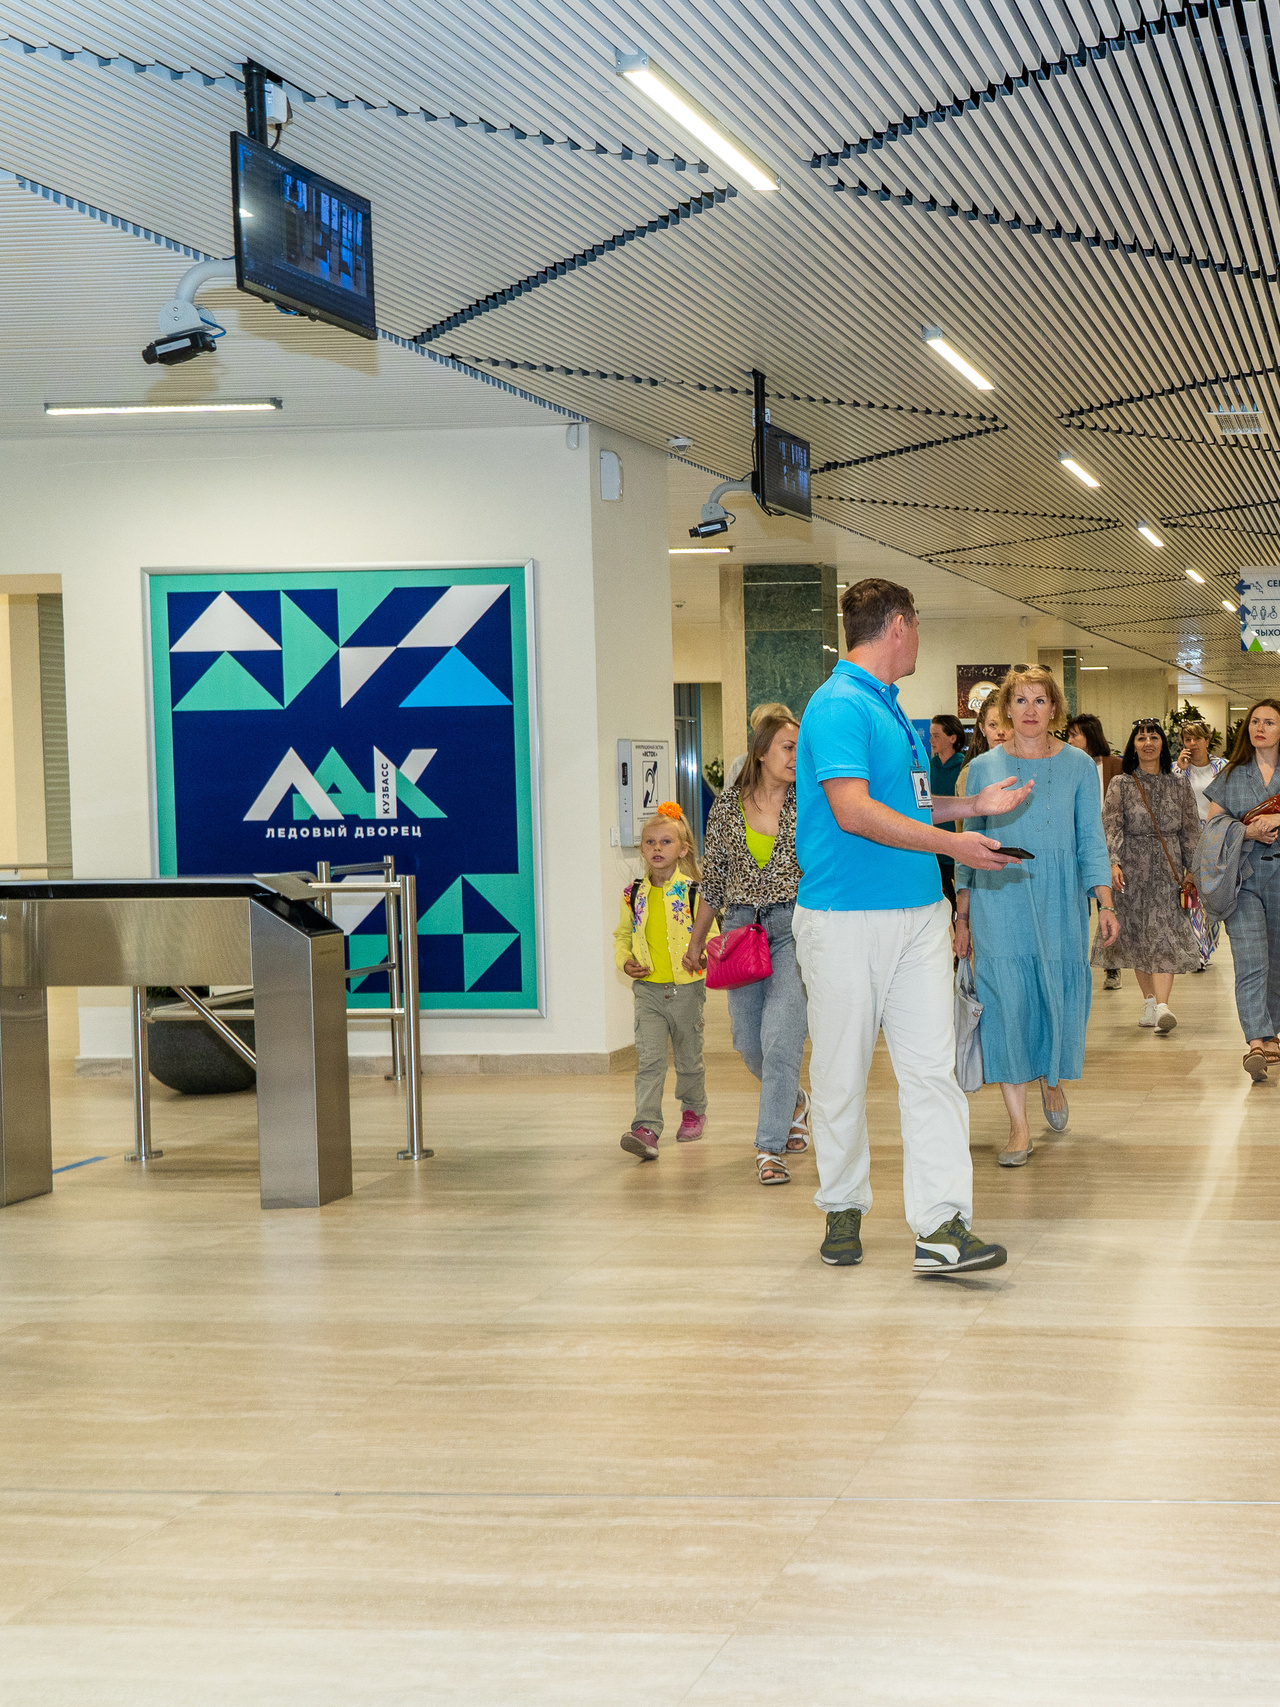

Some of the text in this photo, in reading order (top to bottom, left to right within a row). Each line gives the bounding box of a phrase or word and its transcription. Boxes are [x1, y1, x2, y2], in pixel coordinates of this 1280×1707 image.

[381, 762, 390, 814] КУЗБАСС
[265, 824, 422, 839] ЛЕДОВЫЙ ДВОРЕЦ
